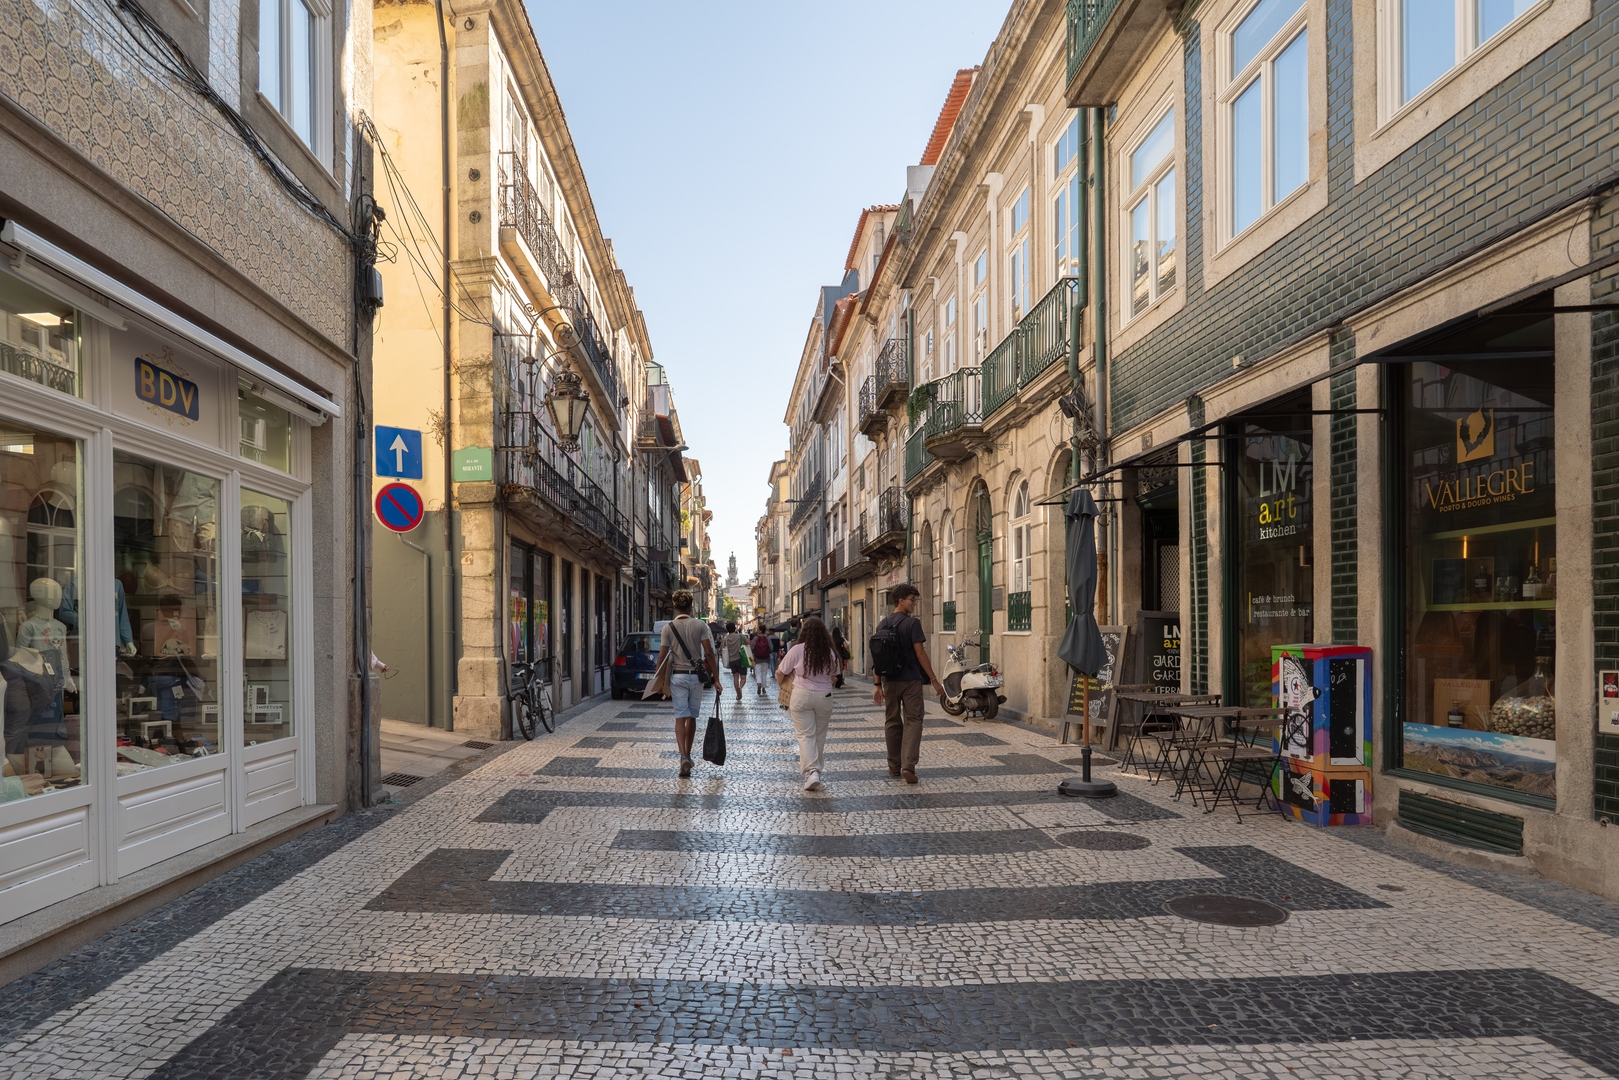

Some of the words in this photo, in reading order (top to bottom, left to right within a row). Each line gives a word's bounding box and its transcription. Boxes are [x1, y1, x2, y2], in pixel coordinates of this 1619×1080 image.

[140, 363, 195, 415] BDV
[1260, 452, 1296, 498] LM
[1425, 461, 1535, 509] VALLEGRE
[1259, 491, 1297, 524] art
[1440, 503, 1460, 513] PORTO
[1467, 498, 1491, 509] DOURO
[1493, 493, 1515, 503] WINES
[1260, 524, 1296, 540] kitchen
[1252, 595, 1265, 604] café
[1265, 595, 1271, 603] &
[1273, 594, 1295, 603] brunch
[1253, 609, 1288, 617] restaurante
[1290, 608, 1296, 617] &
[1298, 608, 1310, 617] bar
[1163, 639, 1181, 649] ar
[1153, 655, 1181, 668] JARD
[1153, 669, 1181, 681] GARD
